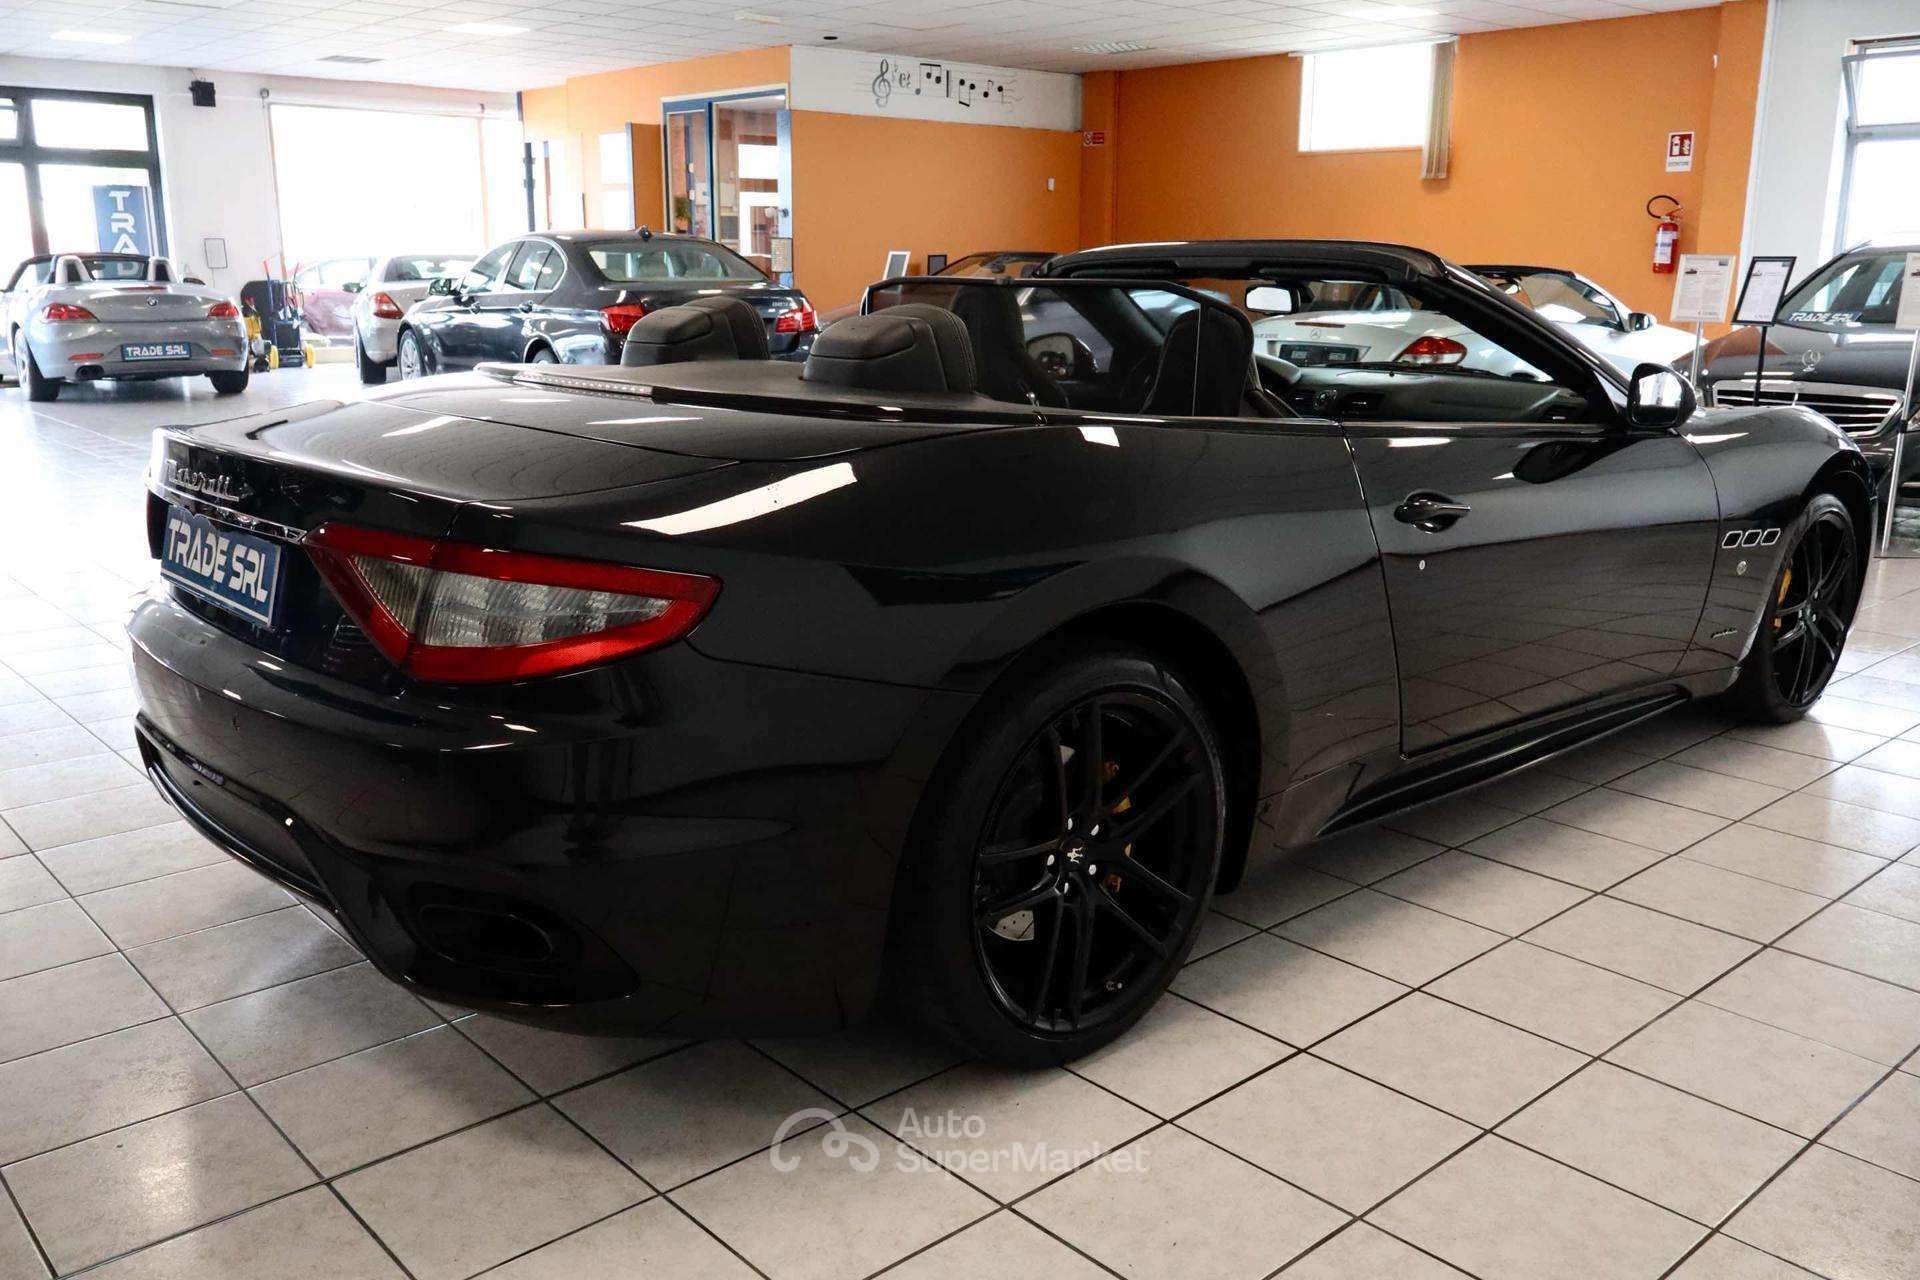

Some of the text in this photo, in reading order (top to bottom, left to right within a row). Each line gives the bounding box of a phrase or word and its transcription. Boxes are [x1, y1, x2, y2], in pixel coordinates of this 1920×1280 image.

[126, 344, 187, 357] TRADE SRL
[168, 518, 268, 603] TRADE SRL
